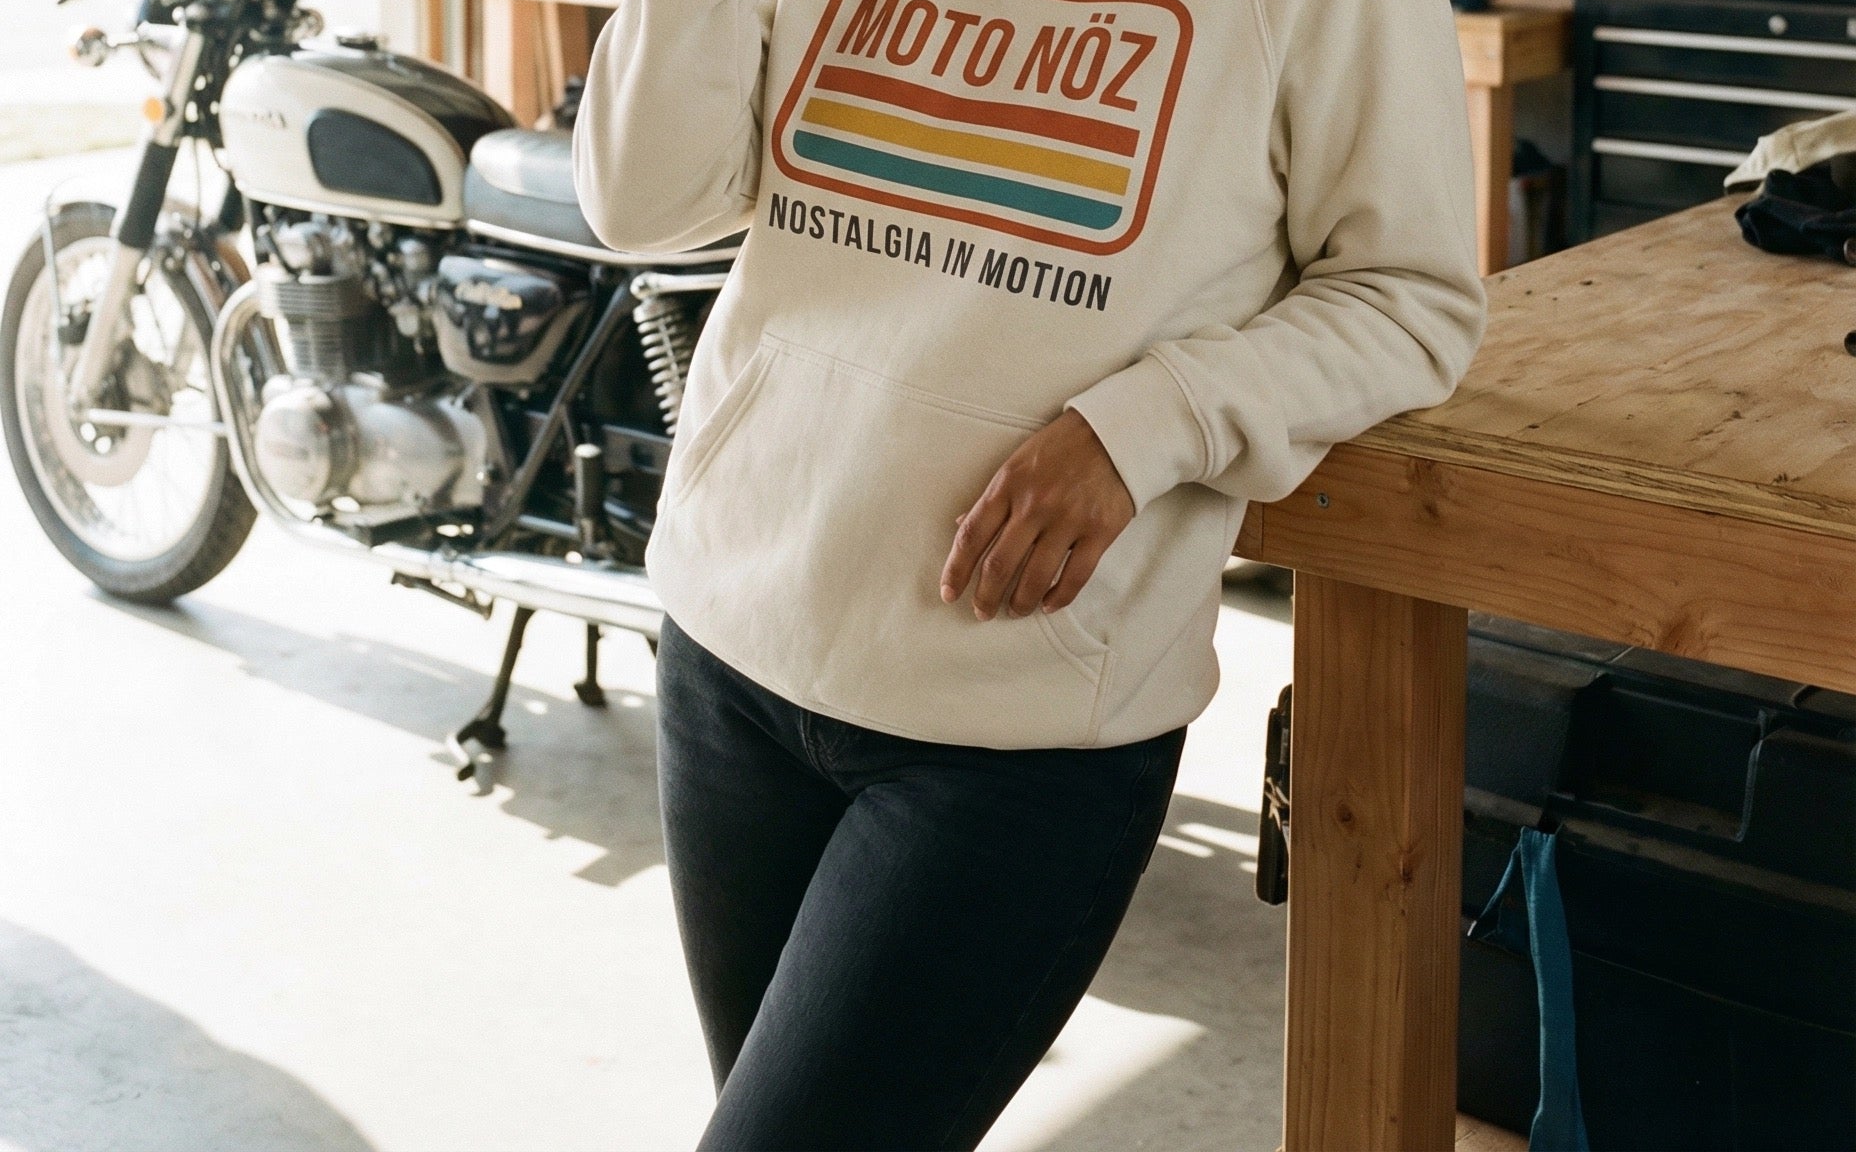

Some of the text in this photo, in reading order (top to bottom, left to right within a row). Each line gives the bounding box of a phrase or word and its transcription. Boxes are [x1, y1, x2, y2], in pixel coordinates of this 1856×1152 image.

[1013, 12, 1158, 113] NÖZ
[768, 192, 1112, 312] NOSTALGIA IN MOTION
